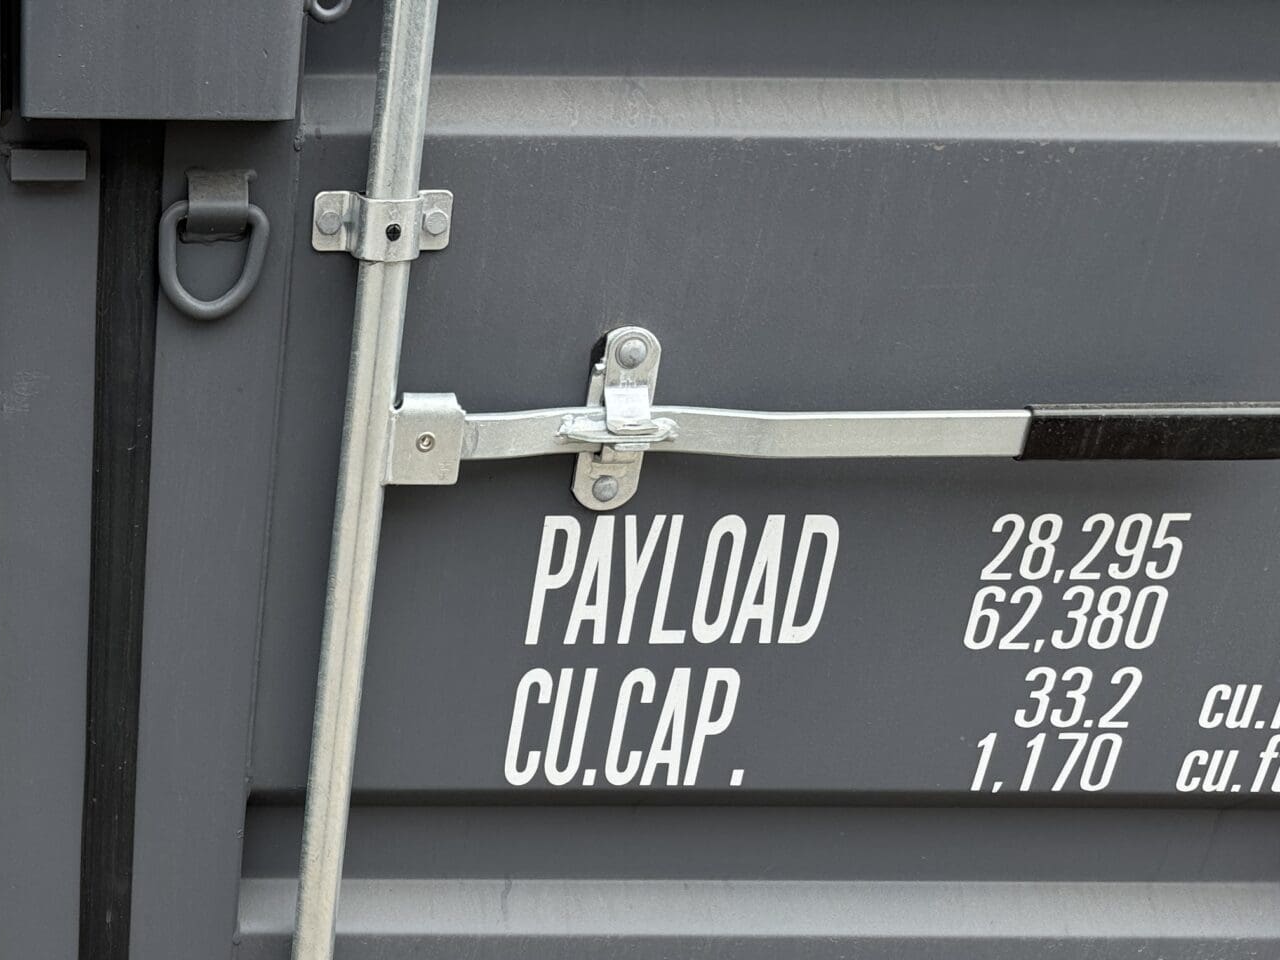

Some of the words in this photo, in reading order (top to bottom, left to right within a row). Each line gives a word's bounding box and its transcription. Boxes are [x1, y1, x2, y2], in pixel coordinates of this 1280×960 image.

[524, 514, 840, 646] PAYLOAD
[980, 512, 1191, 582] 28,295
[963, 585, 1169, 650] 62,380
[504, 667, 746, 787] CU.CAP.
[1014, 666, 1142, 729] 33.2
[970, 733, 1123, 793] 1,170
